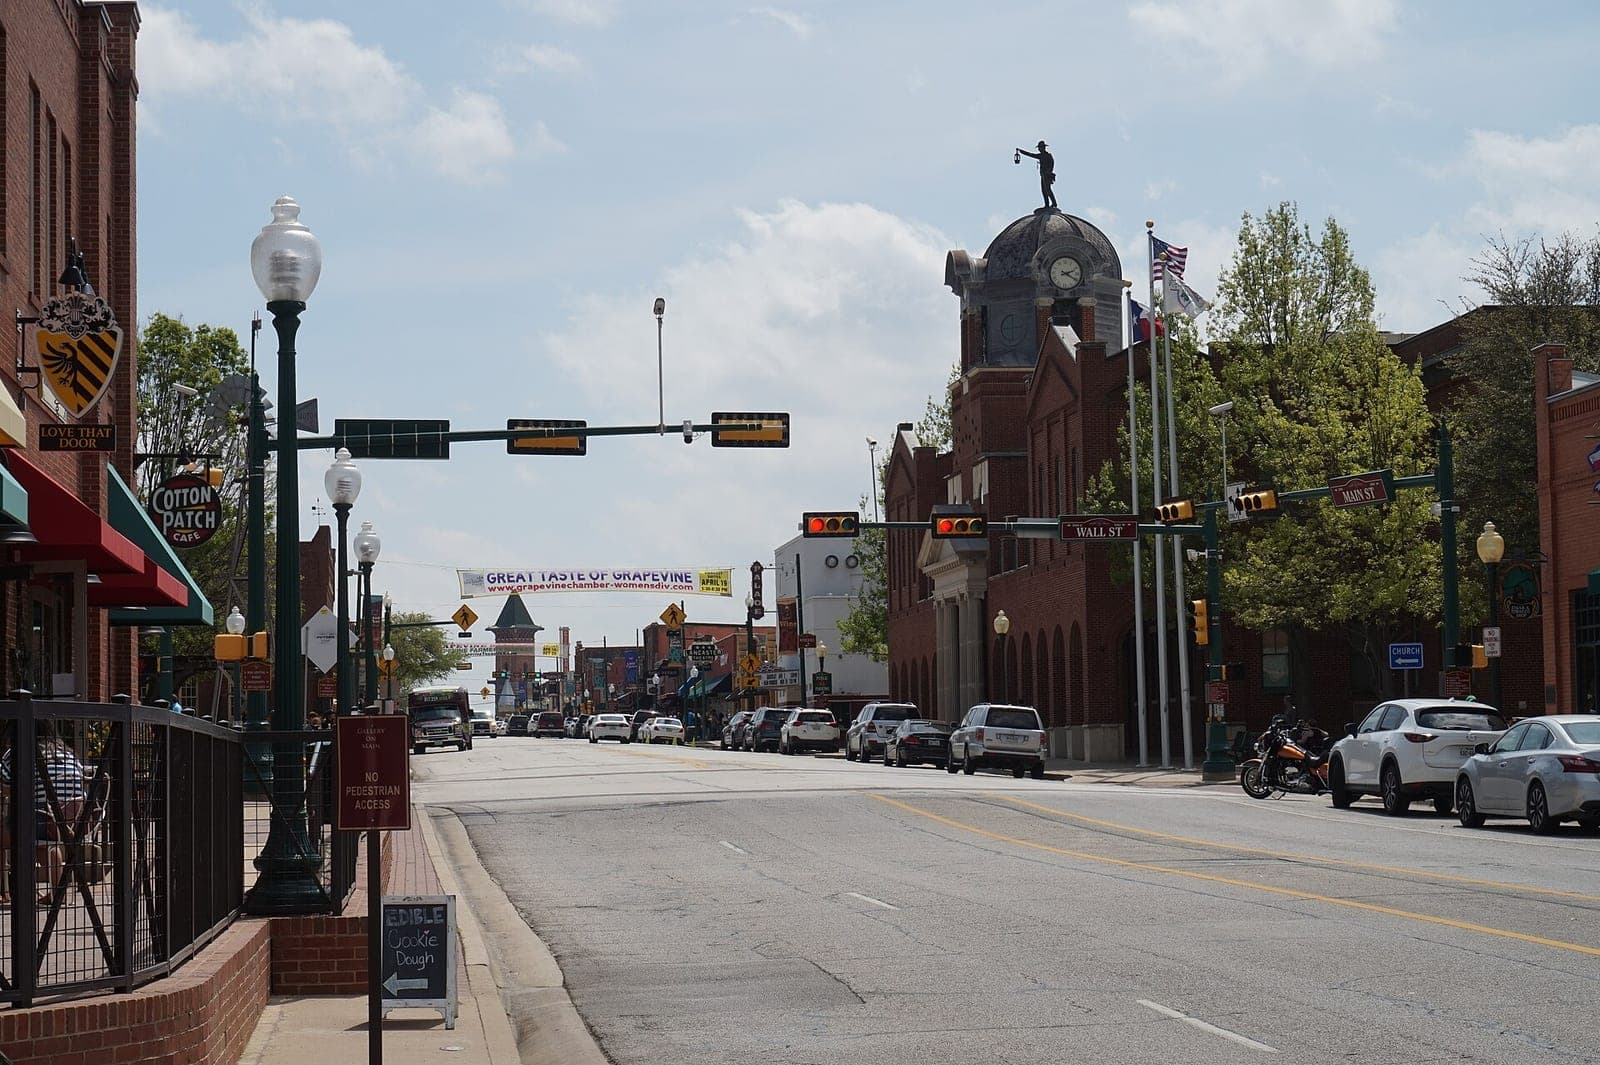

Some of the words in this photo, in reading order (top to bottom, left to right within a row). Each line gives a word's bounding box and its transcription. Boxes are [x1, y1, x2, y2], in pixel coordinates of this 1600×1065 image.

[41, 427, 74, 438] LOVE
[78, 427, 112, 438] THAT
[59, 438, 97, 449] DOOR
[152, 486, 212, 514] COTTON
[1342, 488, 1365, 503] MAIN
[1363, 486, 1376, 500] ST
[163, 510, 216, 536] PATCH
[173, 531, 201, 542] CAFE
[1076, 527, 1106, 538] WALL
[1108, 526, 1124, 537] ST
[486, 572, 533, 584] GREAT
[540, 571, 586, 582] TASTE
[588, 570, 608, 581] OF
[612, 570, 693, 583] GRAPEVINE
[488, 581, 694, 592] www.grapevinechamber-womensdiv.com
[1392, 647, 1420, 656] CHURCH
[365, 771, 379, 782] NO
[345, 785, 401, 797] PEDESTRIAN
[354, 799, 391, 810] ACCESS
[384, 906, 444, 927] EDIBLE
[388, 928, 439, 949] Cookie
[395, 950, 435, 971] Dough
